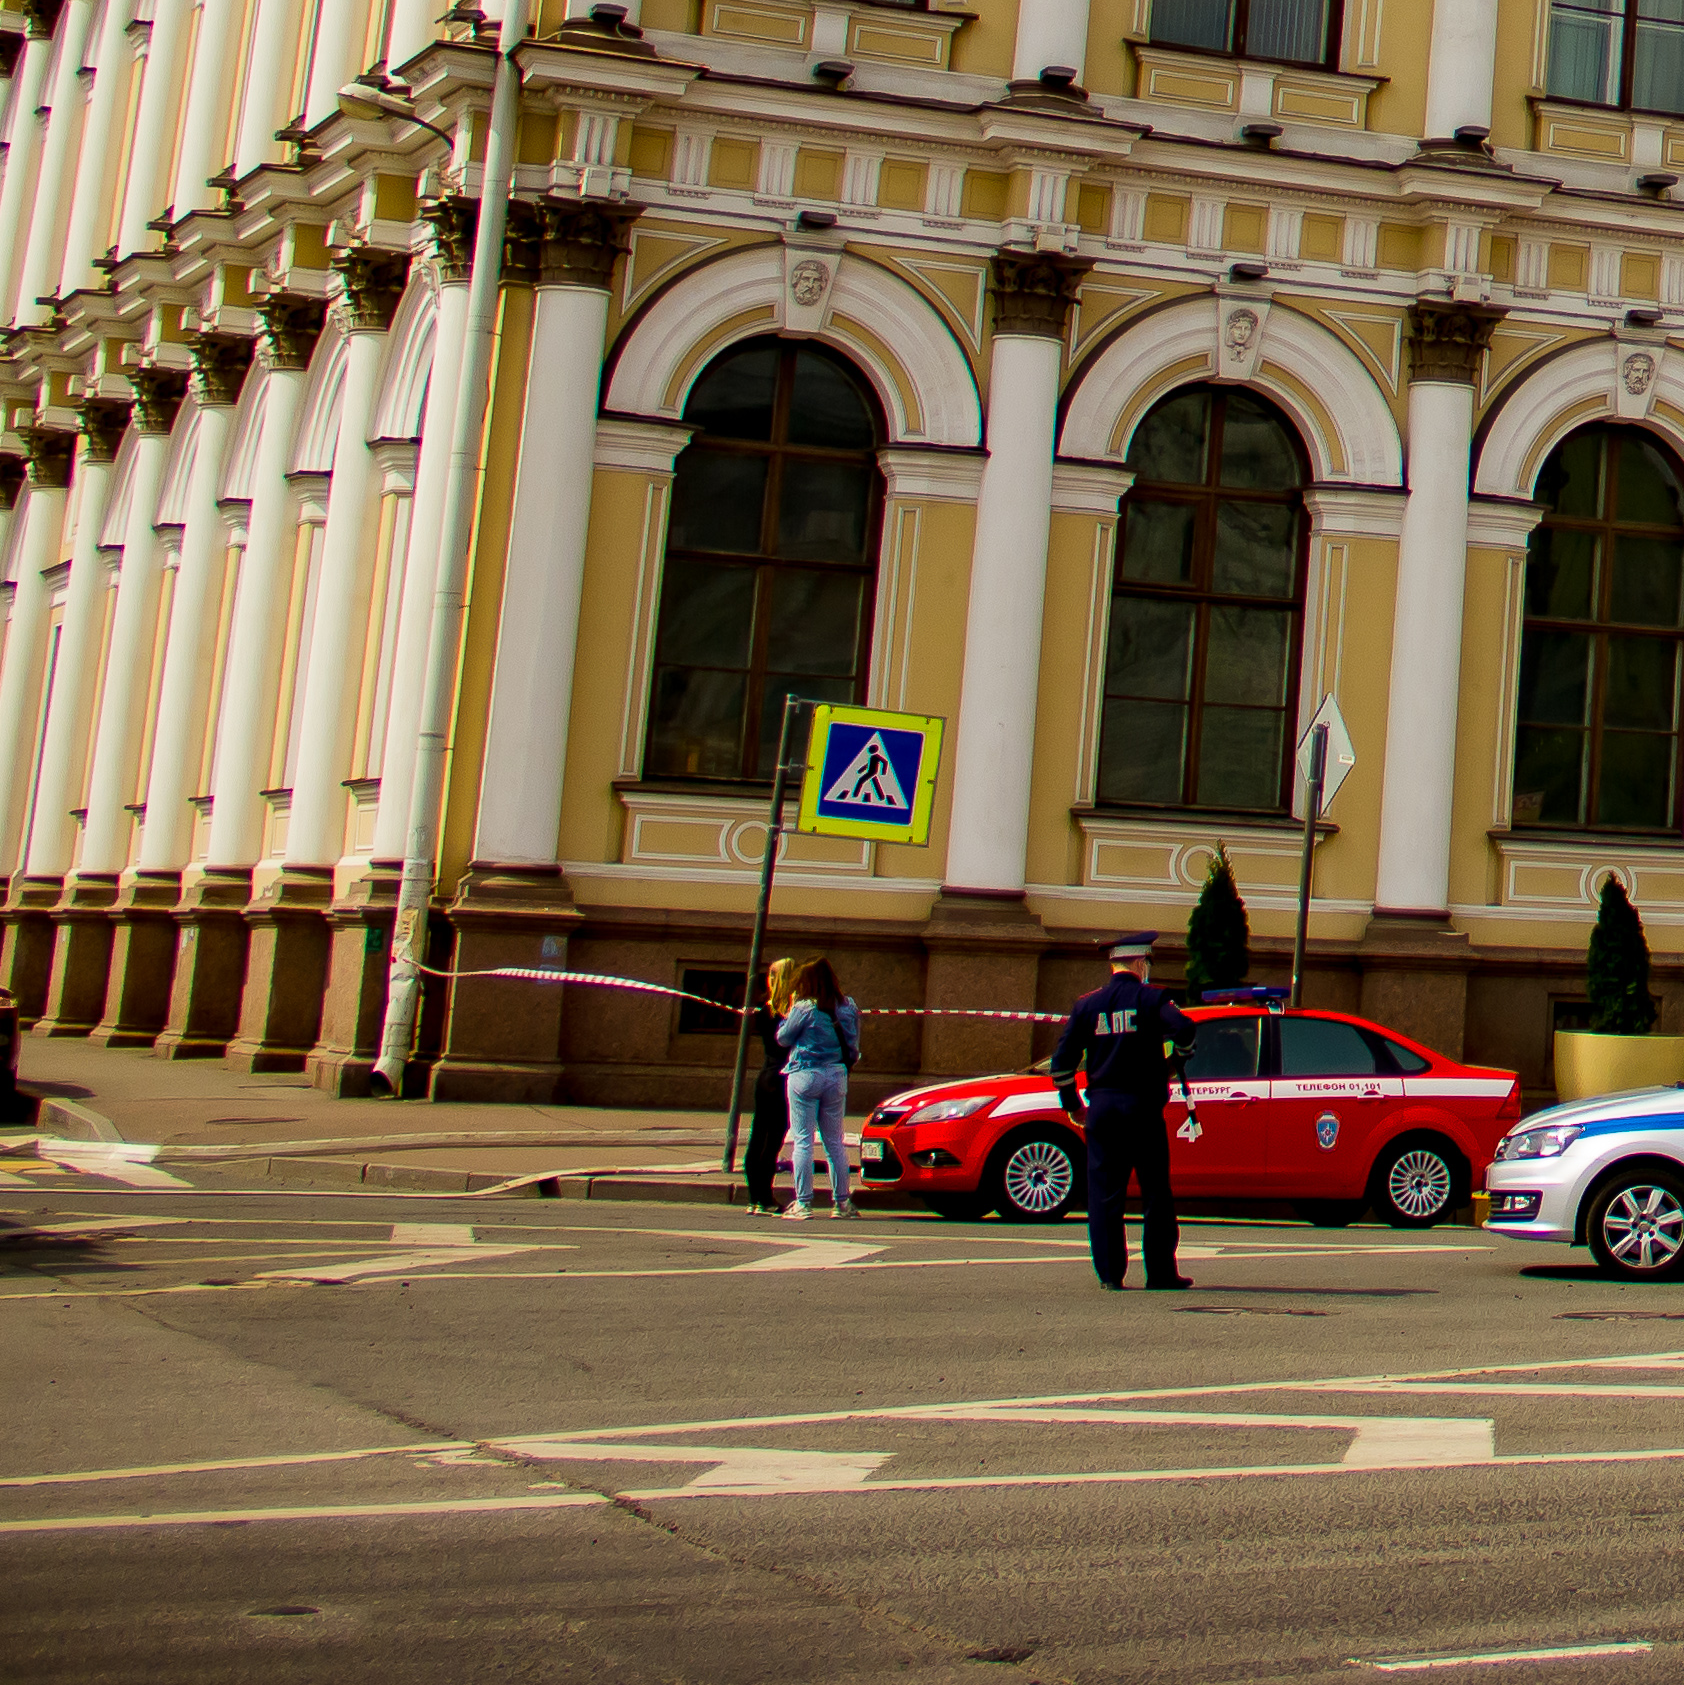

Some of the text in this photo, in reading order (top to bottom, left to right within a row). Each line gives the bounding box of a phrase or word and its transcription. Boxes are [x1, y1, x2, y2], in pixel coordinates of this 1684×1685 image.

[1095, 1009, 1137, 1035] ДПС
[1296, 1083, 1346, 1092] ТЕЛЕФОН
[1176, 1115, 1199, 1144] 4
